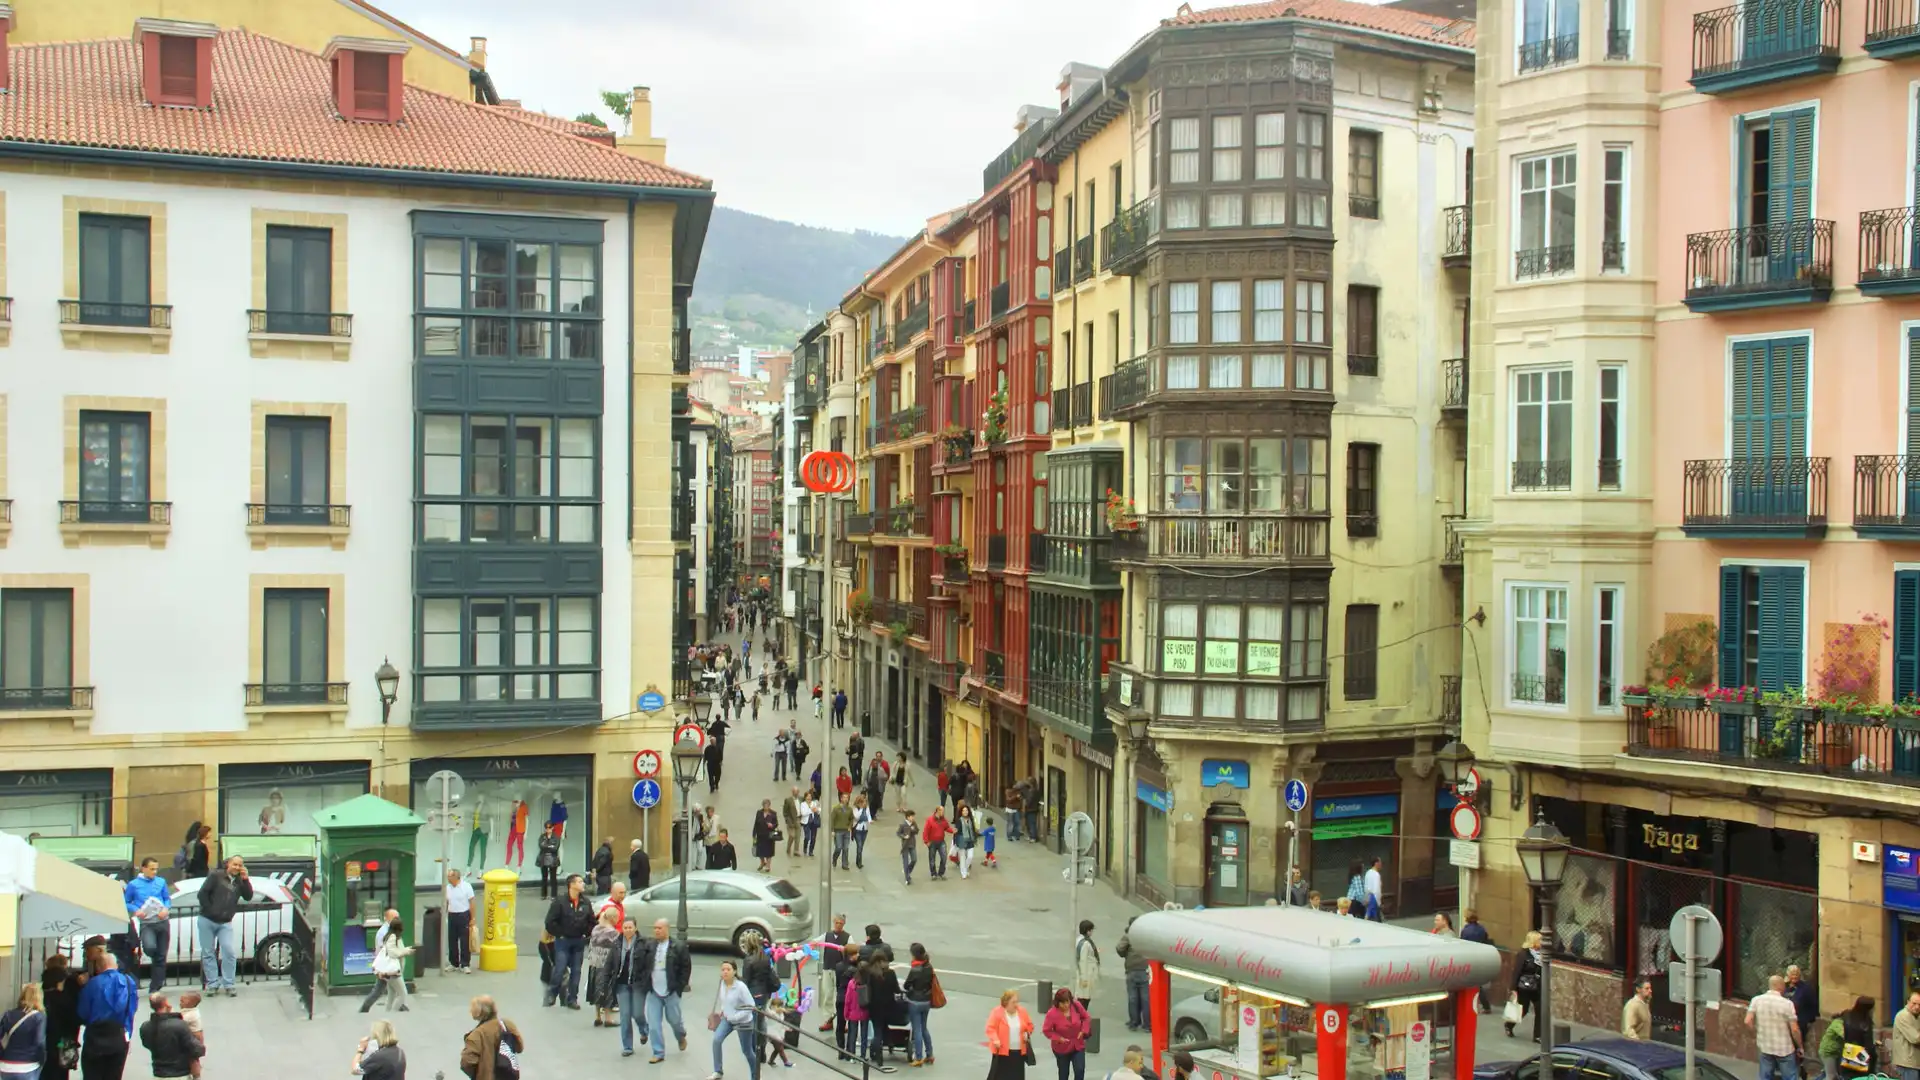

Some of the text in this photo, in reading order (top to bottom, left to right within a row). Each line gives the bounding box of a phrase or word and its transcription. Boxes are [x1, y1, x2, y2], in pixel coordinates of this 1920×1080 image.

[1166, 643, 1195, 656] SE VENDE
[1174, 658, 1187, 669] PISO
[277, 765, 314, 777] ZARA
[485, 759, 520, 771] ZARA
[17, 774, 59, 785] ZARA
[483, 892, 496, 941] CORREOS
[1169, 935, 1228, 968] Helados
[1363, 960, 1421, 987] Helados
